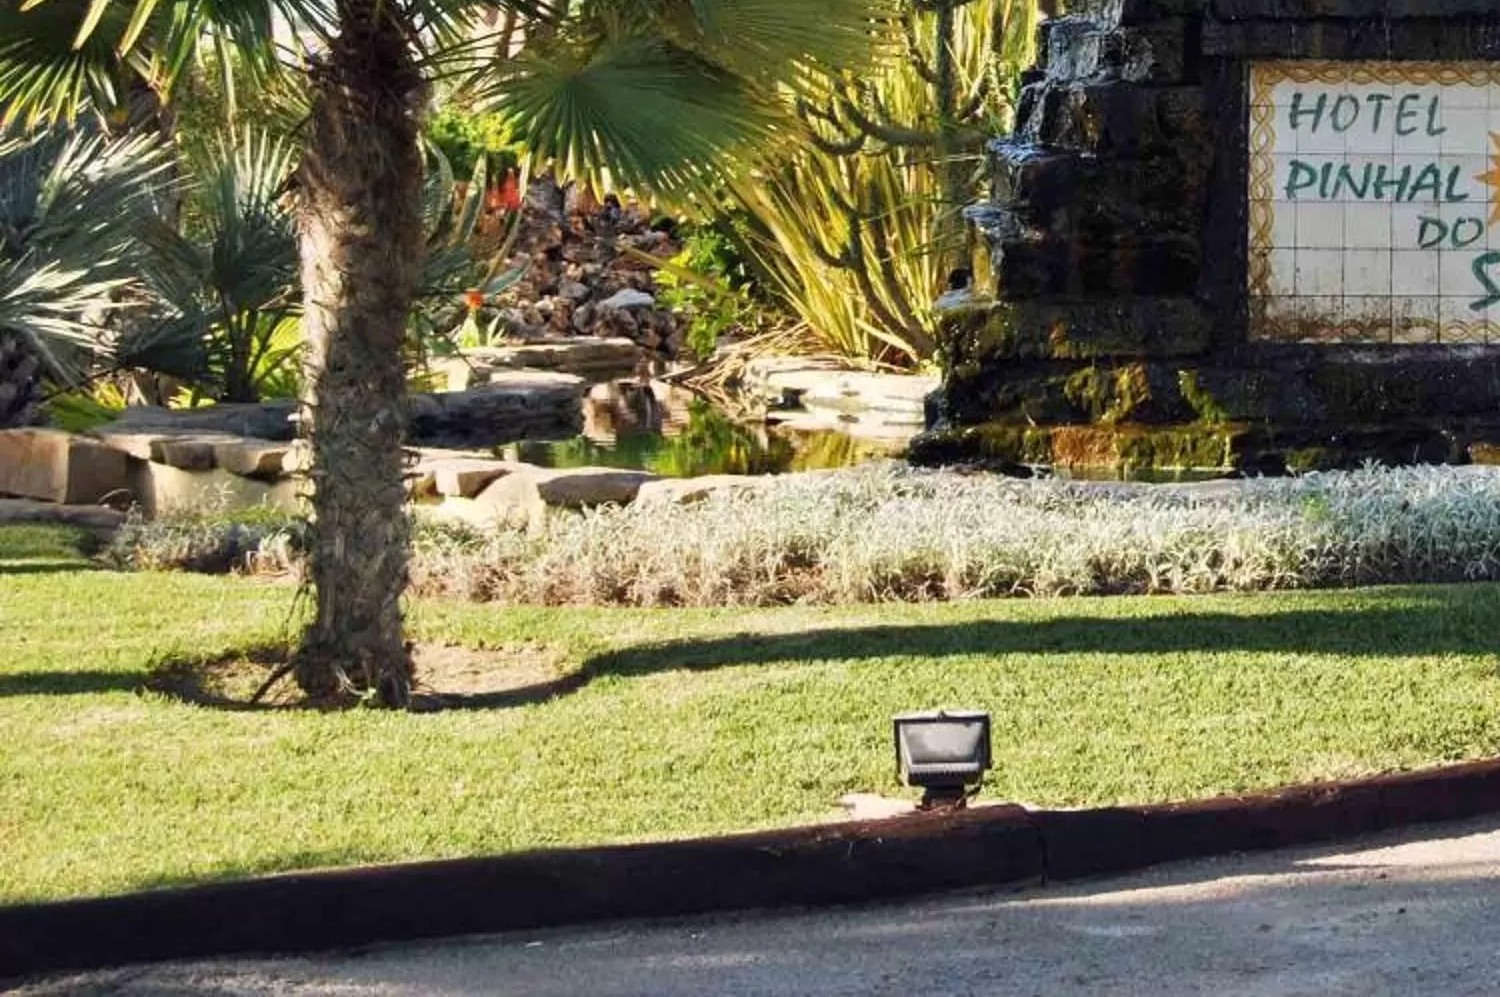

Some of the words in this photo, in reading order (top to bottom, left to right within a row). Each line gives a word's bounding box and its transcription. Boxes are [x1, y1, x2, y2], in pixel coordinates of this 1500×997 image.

[1287, 92, 1447, 137] HOTEL
[1284, 158, 1469, 203] PINHAL
[1416, 215, 1485, 250] DO
